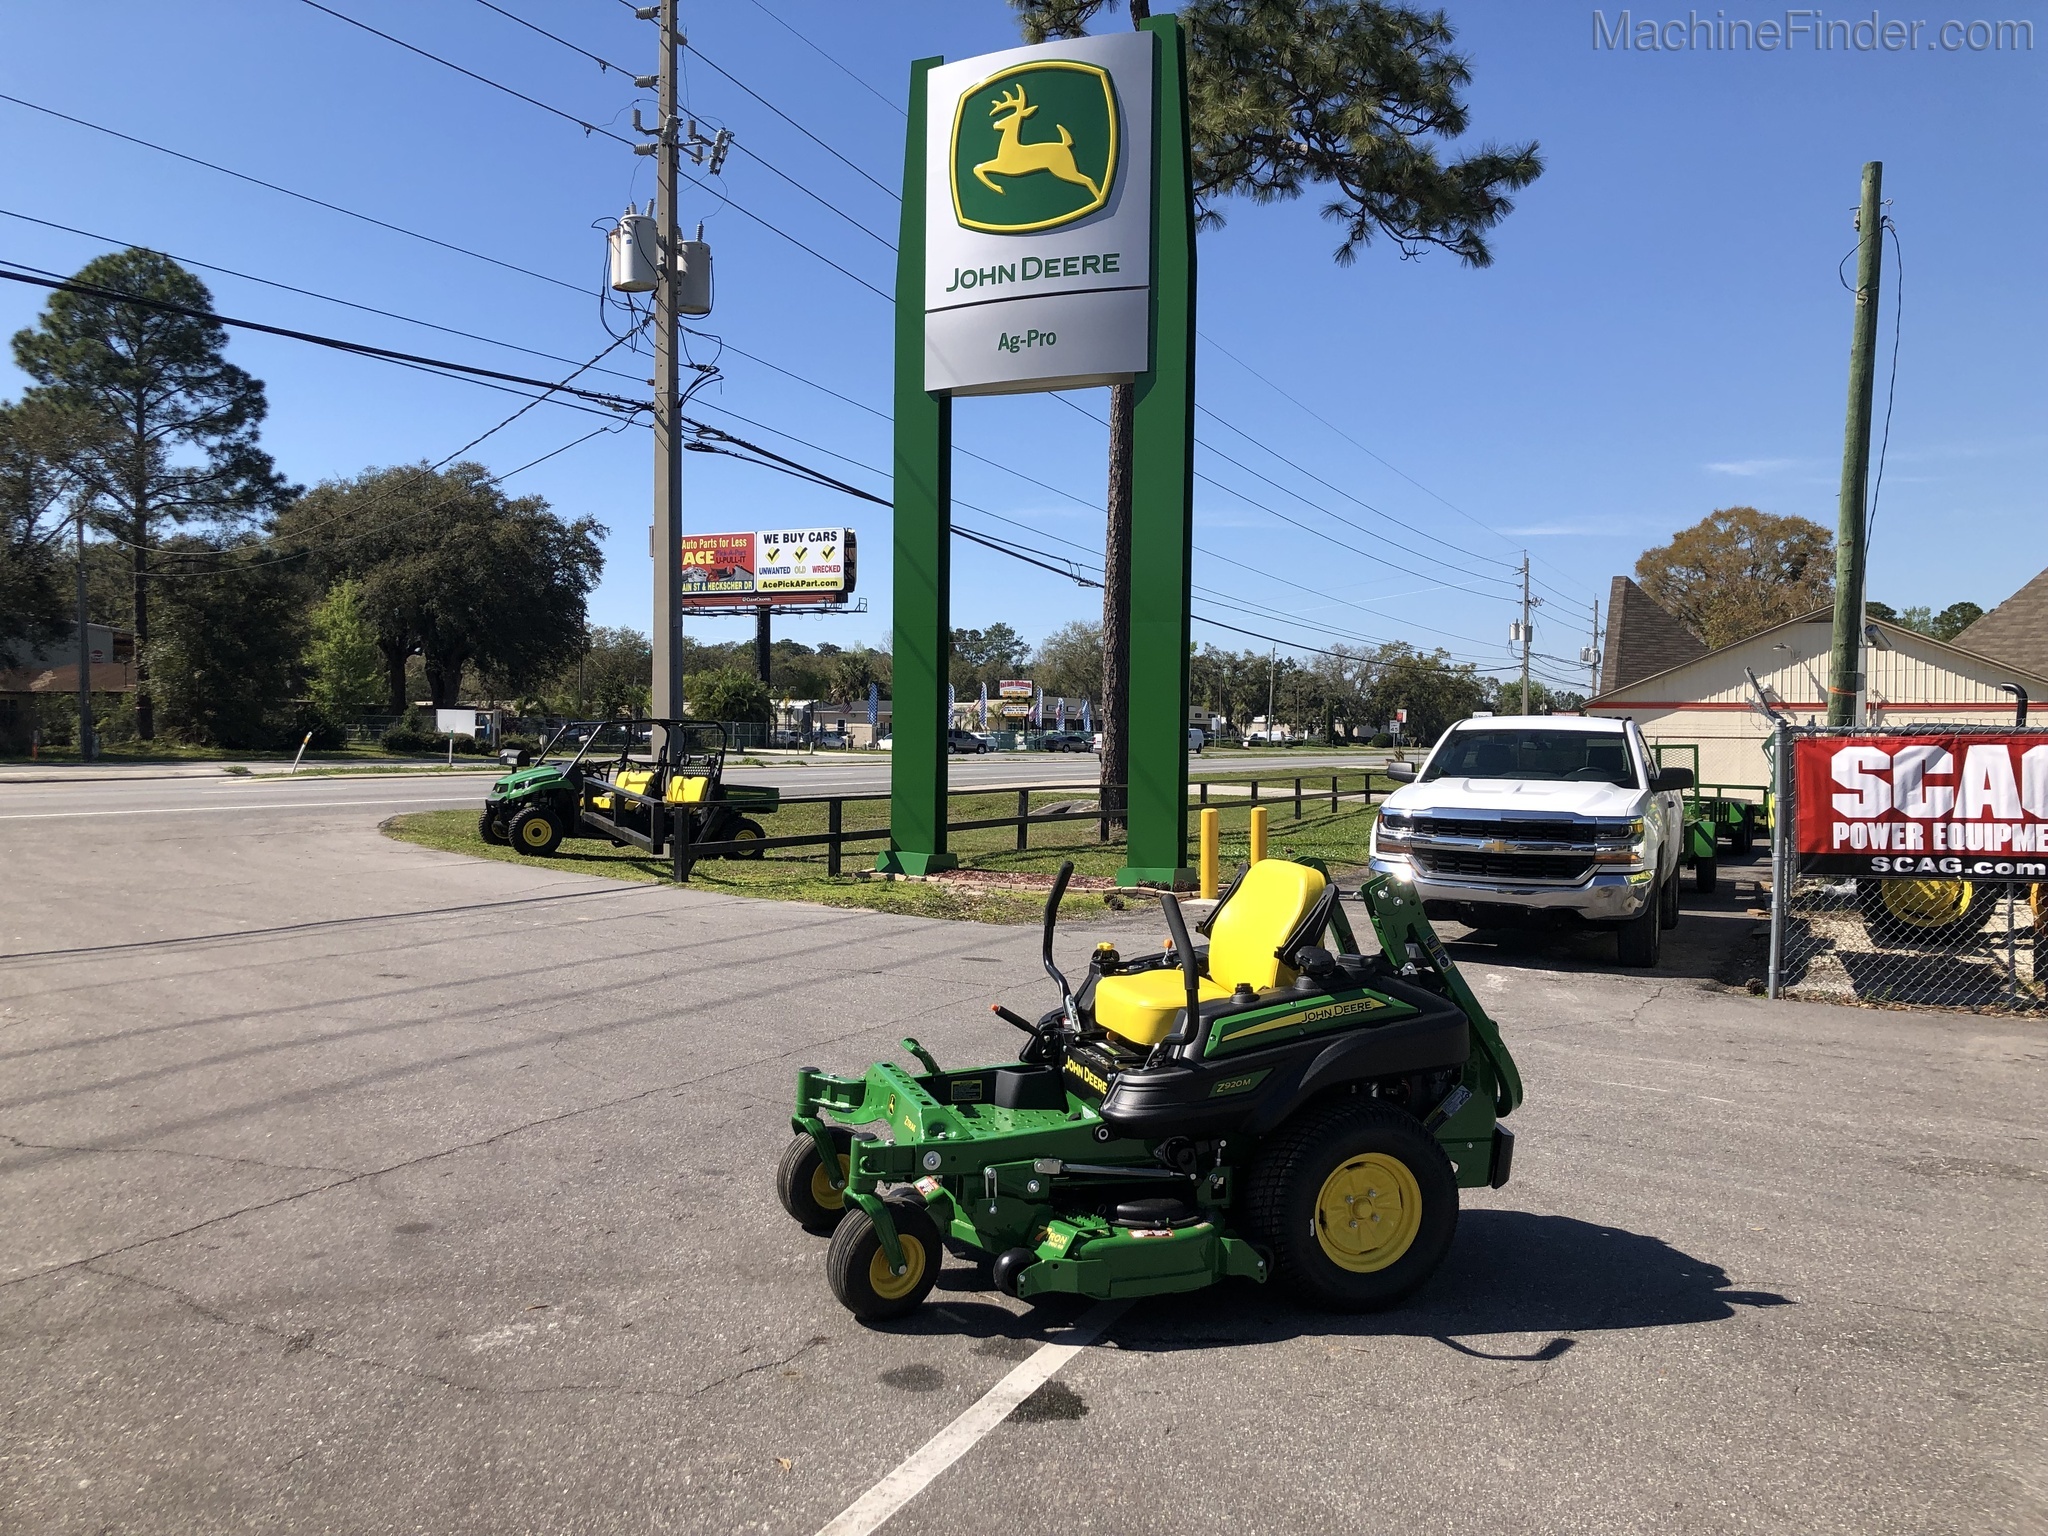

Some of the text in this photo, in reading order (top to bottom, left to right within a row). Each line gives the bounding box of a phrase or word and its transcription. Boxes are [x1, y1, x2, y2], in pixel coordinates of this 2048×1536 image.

[946, 253, 1120, 292] JOHN DEERE
[997, 329, 1057, 353] Ag-Pro
[682, 537, 747, 549] Auto Parts for Less
[763, 531, 837, 544] WE BUY CARS
[682, 550, 715, 566] ACE
[759, 566, 791, 575] UNWANTED
[794, 565, 807, 574] OLD
[812, 565, 841, 573] WRECKED
[682, 580, 753, 592] AIN ST & HECKSCHER DR
[762, 580, 838, 588] AcePickAPart.com
[1833, 822, 2048, 852] POWER EQUIPME
[1871, 857, 2046, 876] SCAG.com
[1302, 1000, 1372, 1023] JOHN DEERE
[1065, 1055, 1108, 1095] JOHN DEERE
[1216, 1078, 1251, 1093] Z920M
